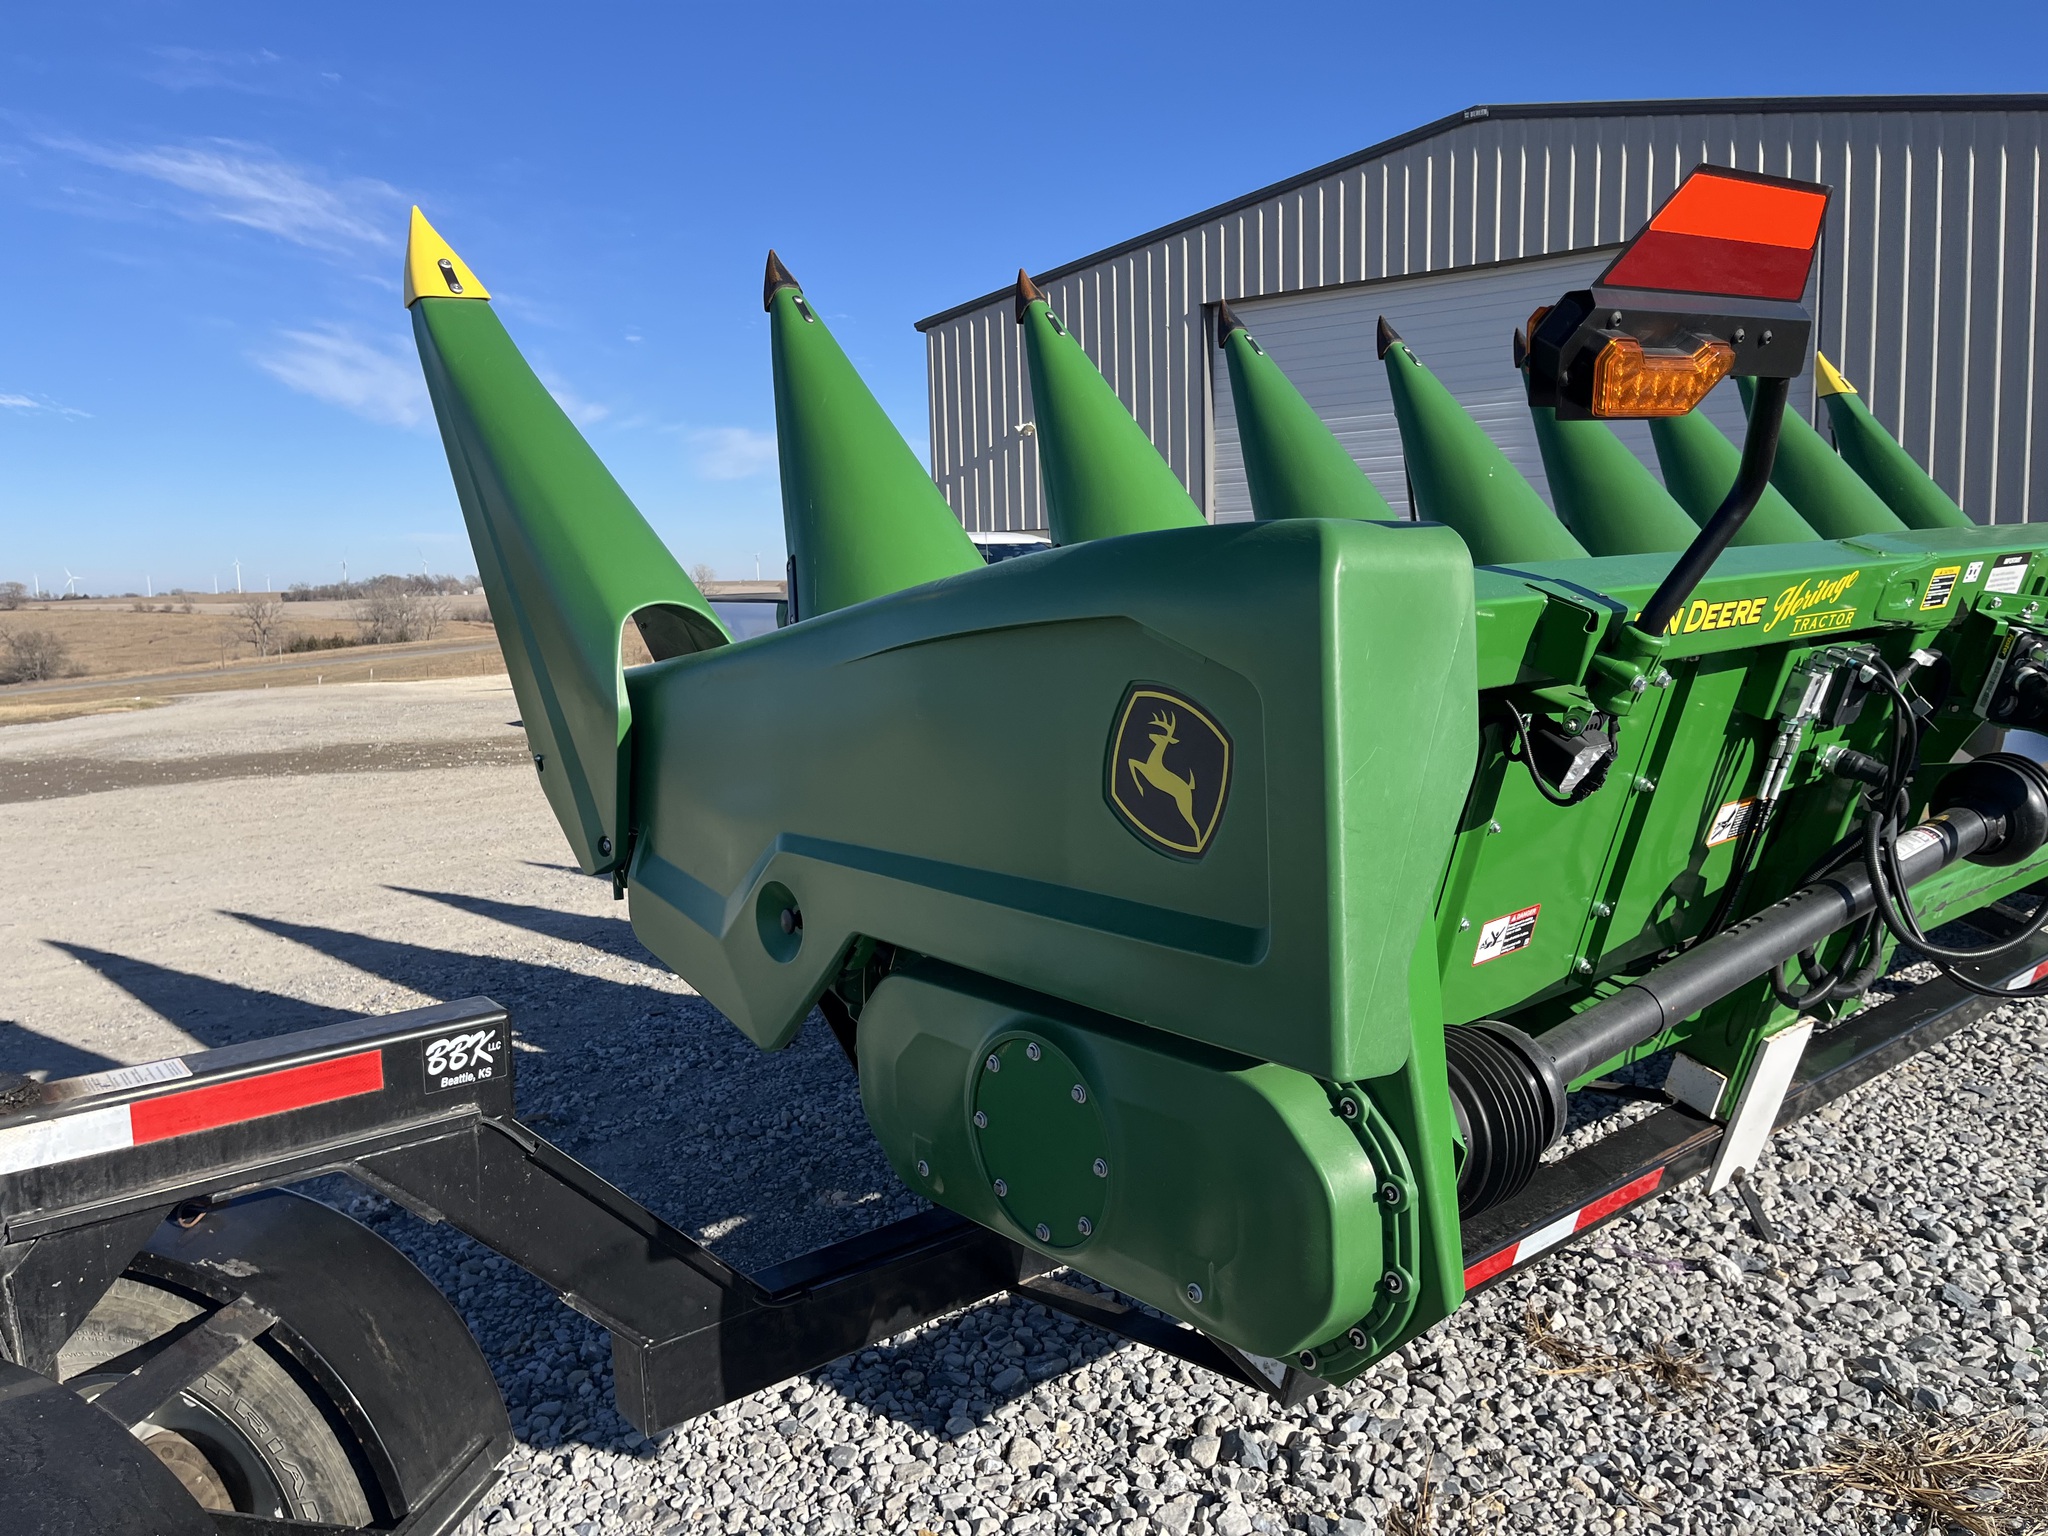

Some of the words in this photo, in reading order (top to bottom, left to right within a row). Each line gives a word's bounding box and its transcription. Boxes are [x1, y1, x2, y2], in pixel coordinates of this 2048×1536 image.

[1682, 597, 1769, 635] DEERE
[1763, 570, 1860, 633] Heritage
[1793, 611, 1855, 632] TRACTOR
[425, 1029, 496, 1076] BBK
[487, 1041, 502, 1052] LLC
[478, 1066, 493, 1079] KS
